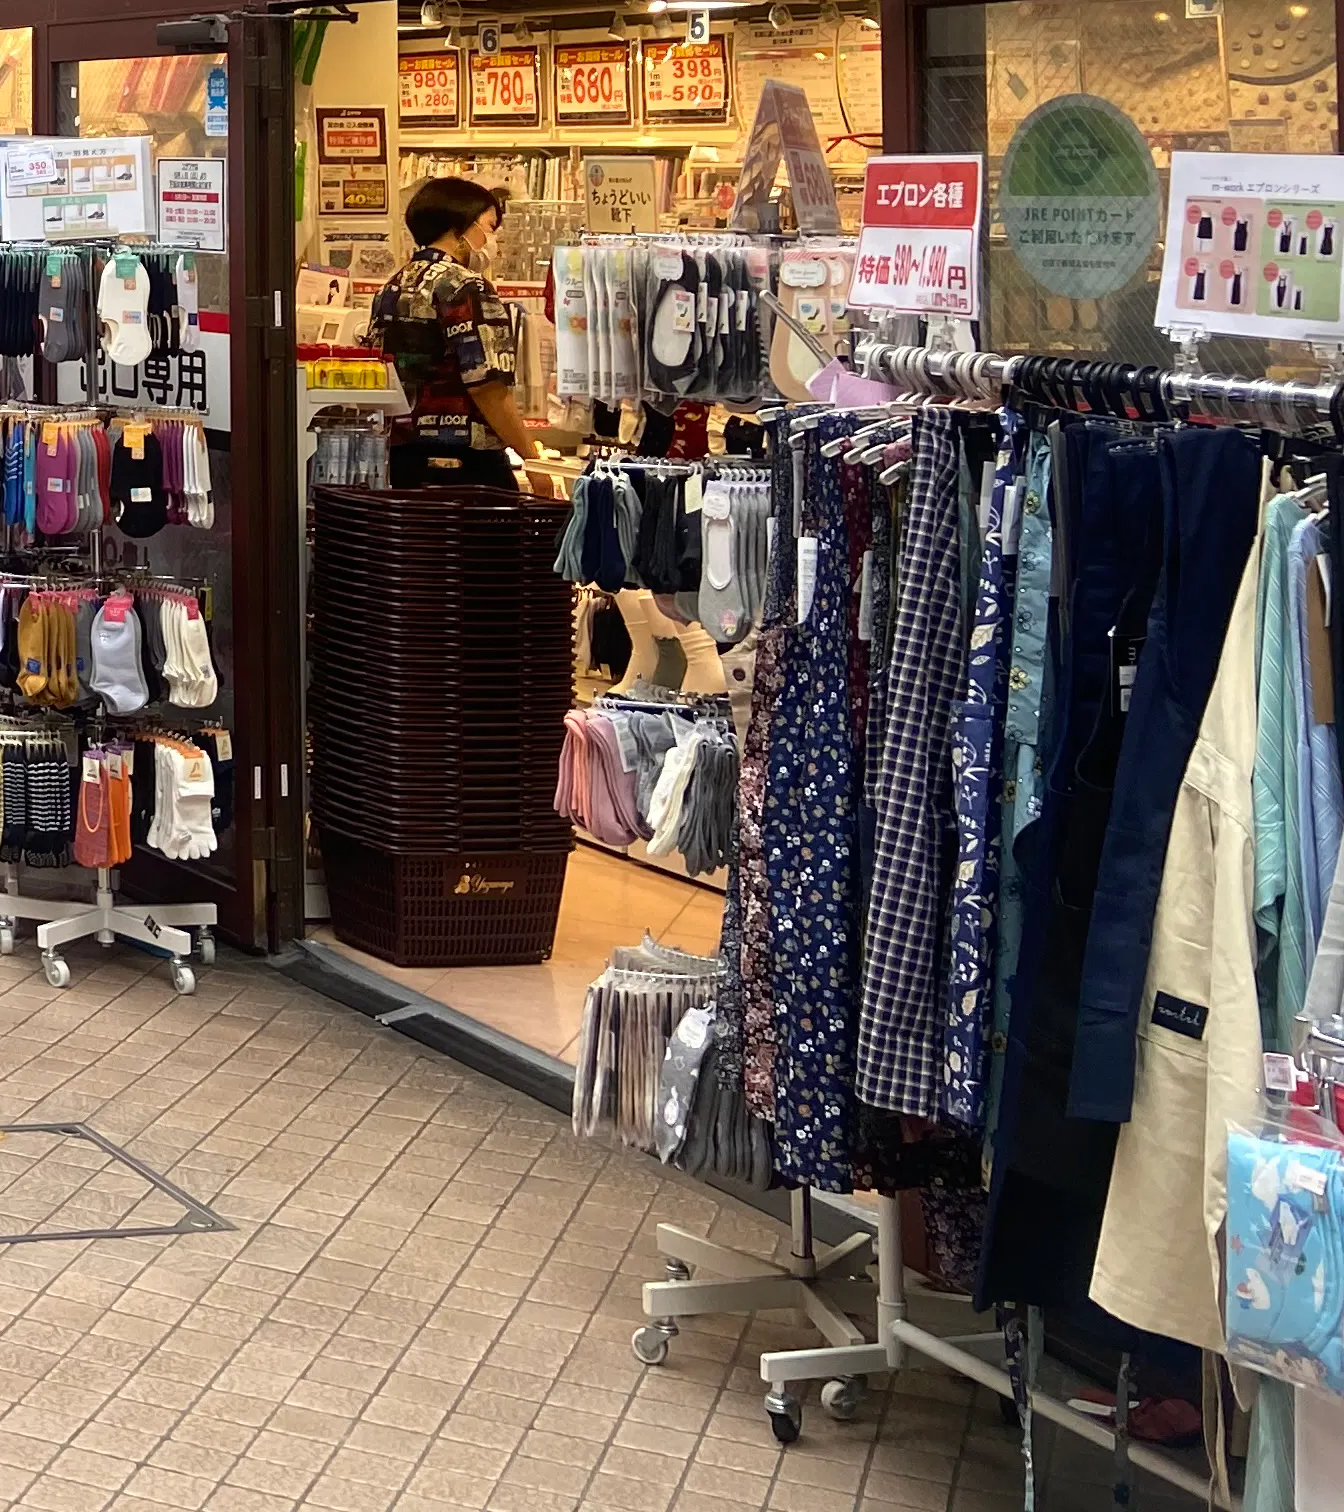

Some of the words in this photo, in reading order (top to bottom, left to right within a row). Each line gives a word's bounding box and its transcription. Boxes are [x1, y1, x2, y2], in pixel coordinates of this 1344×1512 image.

[691, 13, 705, 40] 5
[482, 29, 497, 52] 6
[592, 188, 652, 206] ちょうどいい
[876, 181, 965, 209] エプロン各種
[611, 207, 632, 223] 靴下
[1024, 207, 1048, 222] JRE
